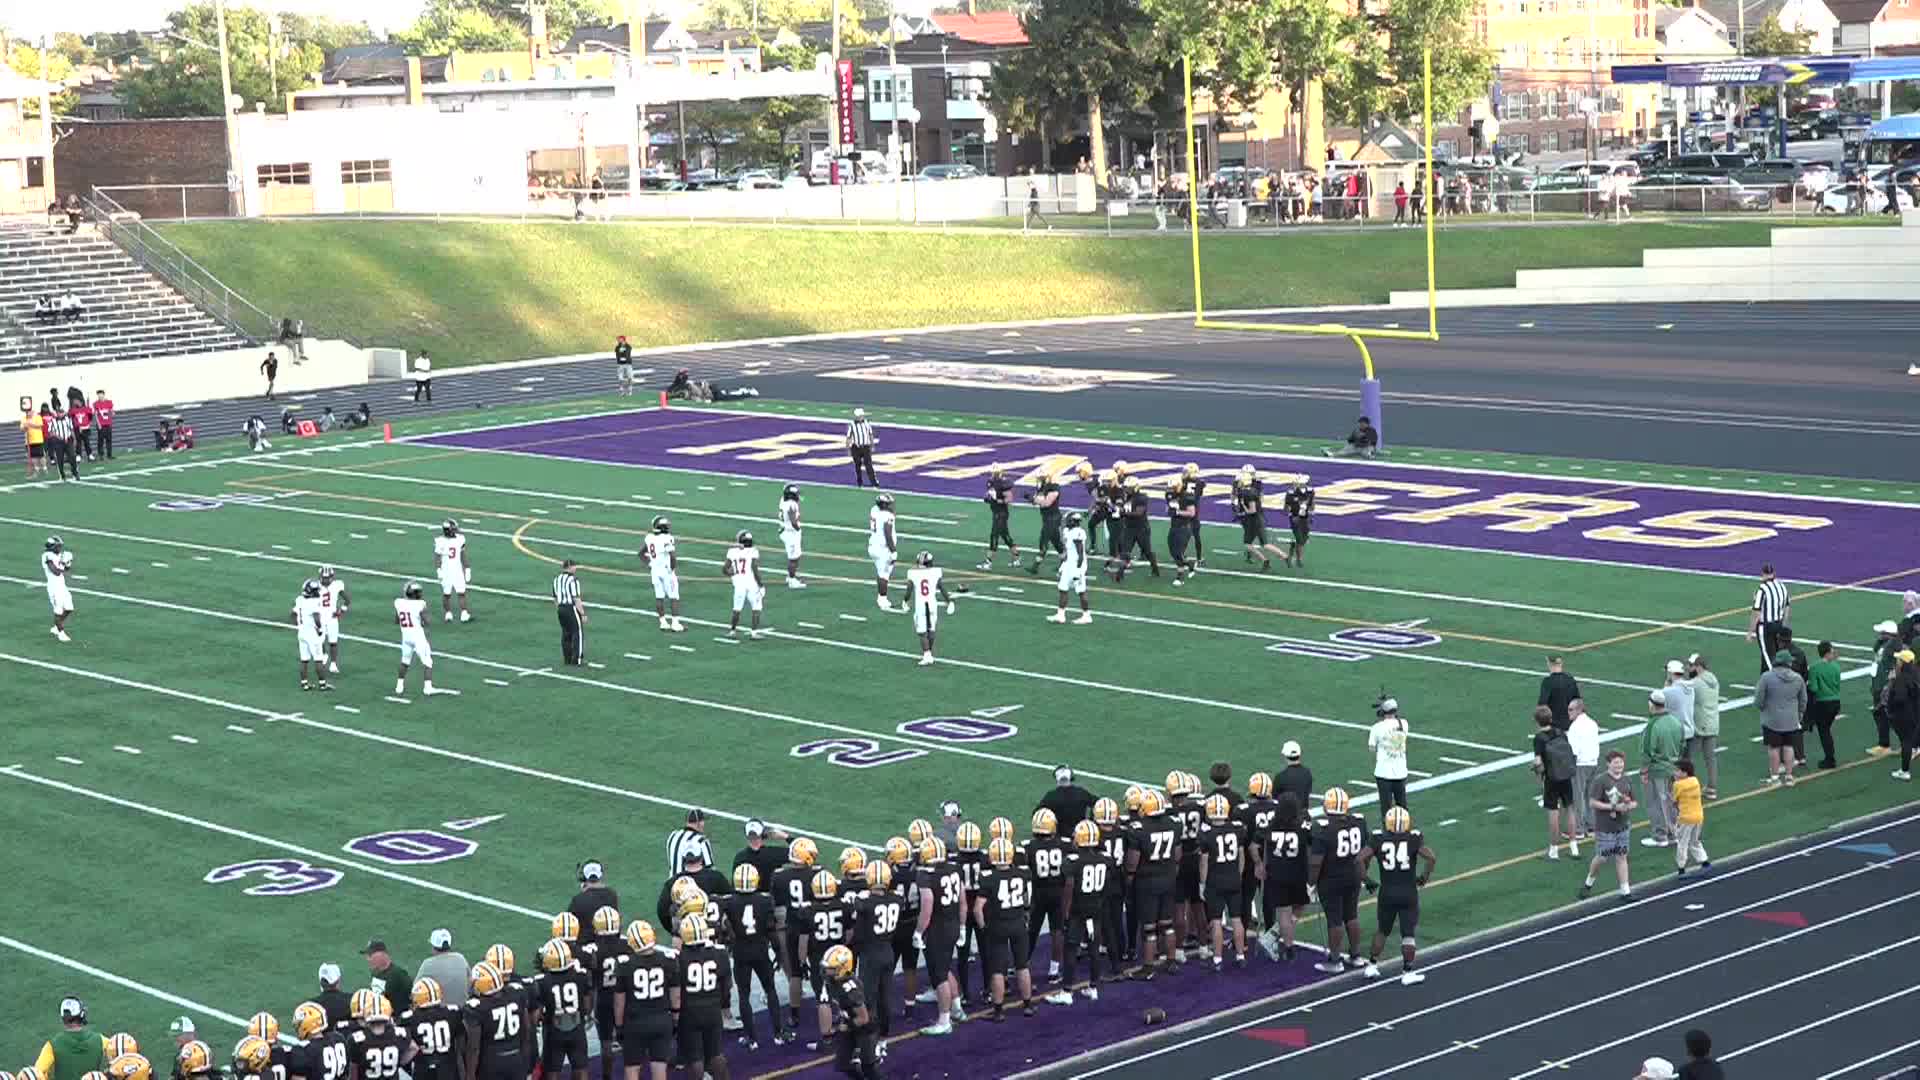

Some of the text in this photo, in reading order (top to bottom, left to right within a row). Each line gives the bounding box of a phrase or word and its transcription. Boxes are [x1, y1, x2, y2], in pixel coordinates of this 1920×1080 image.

[1701, 65, 1762, 81] SUNOCO
[448, 547, 457, 559] 3
[650, 543, 657, 559] 8
[920, 579, 930, 596] 6
[399, 611, 414, 628] 21
[790, 716, 1018, 768] 20
[1150, 830, 1175, 860] 77
[1215, 833, 1239, 863] 13
[1271, 831, 1299, 858] 73
[1336, 826, 1362, 858] 68
[1381, 841, 1411, 871] 34
[203, 829, 479, 895] 30
[1035, 848, 1063, 878] 89
[940, 871, 961, 906] 33
[997, 877, 1024, 909] 42
[1081, 863, 1107, 893] 80
[741, 904, 757, 935] 4
[813, 910, 843, 941] 35
[873, 903, 900, 935] 38
[633, 967, 665, 1000] 92
[686, 960, 718, 992] 96
[551, 982, 580, 1015] 19
[491, 1002, 521, 1041] 76
[417, 1020, 450, 1055] 30
[365, 1046, 399, 1079] 39
